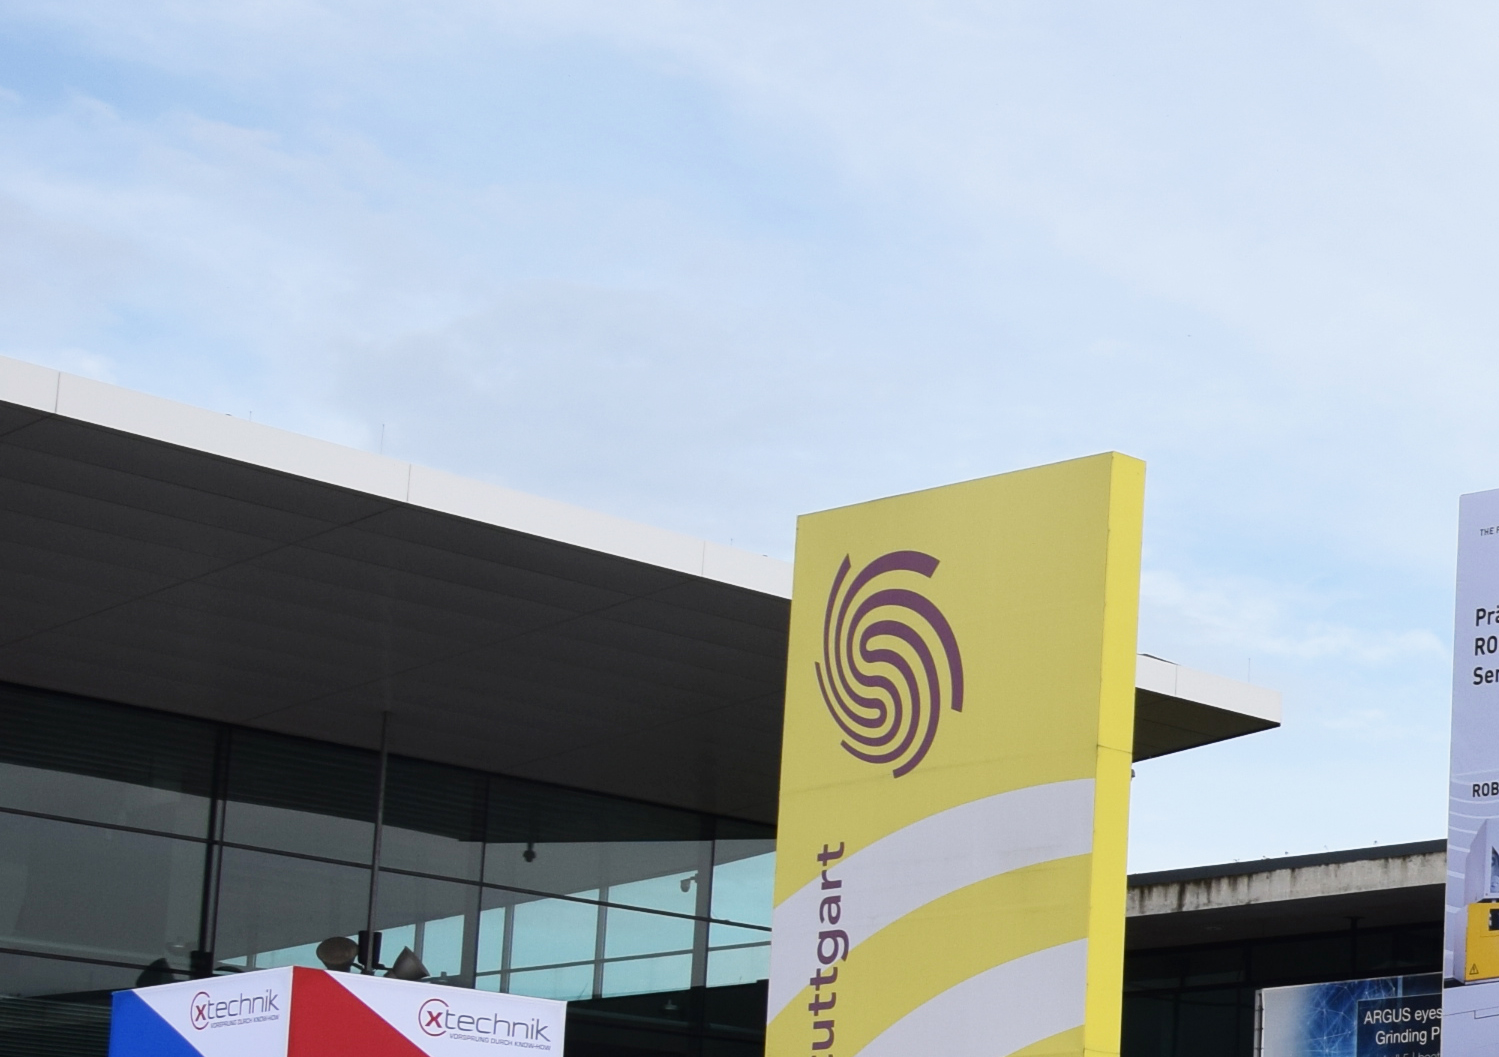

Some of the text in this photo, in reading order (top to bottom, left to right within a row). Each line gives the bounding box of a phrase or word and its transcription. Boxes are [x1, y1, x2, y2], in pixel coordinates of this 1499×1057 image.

[1480, 526, 1494, 536] THE
[193, 989, 279, 1024] xtechnik
[424, 1005, 551, 1042] xtechnik
[1364, 1008, 1442, 1024] ARGUS eyes
[449, 1033, 490, 1044] VORSPRUNG
[490, 1038, 513, 1046] DURCH
[1376, 1029, 1427, 1045] Grinding
